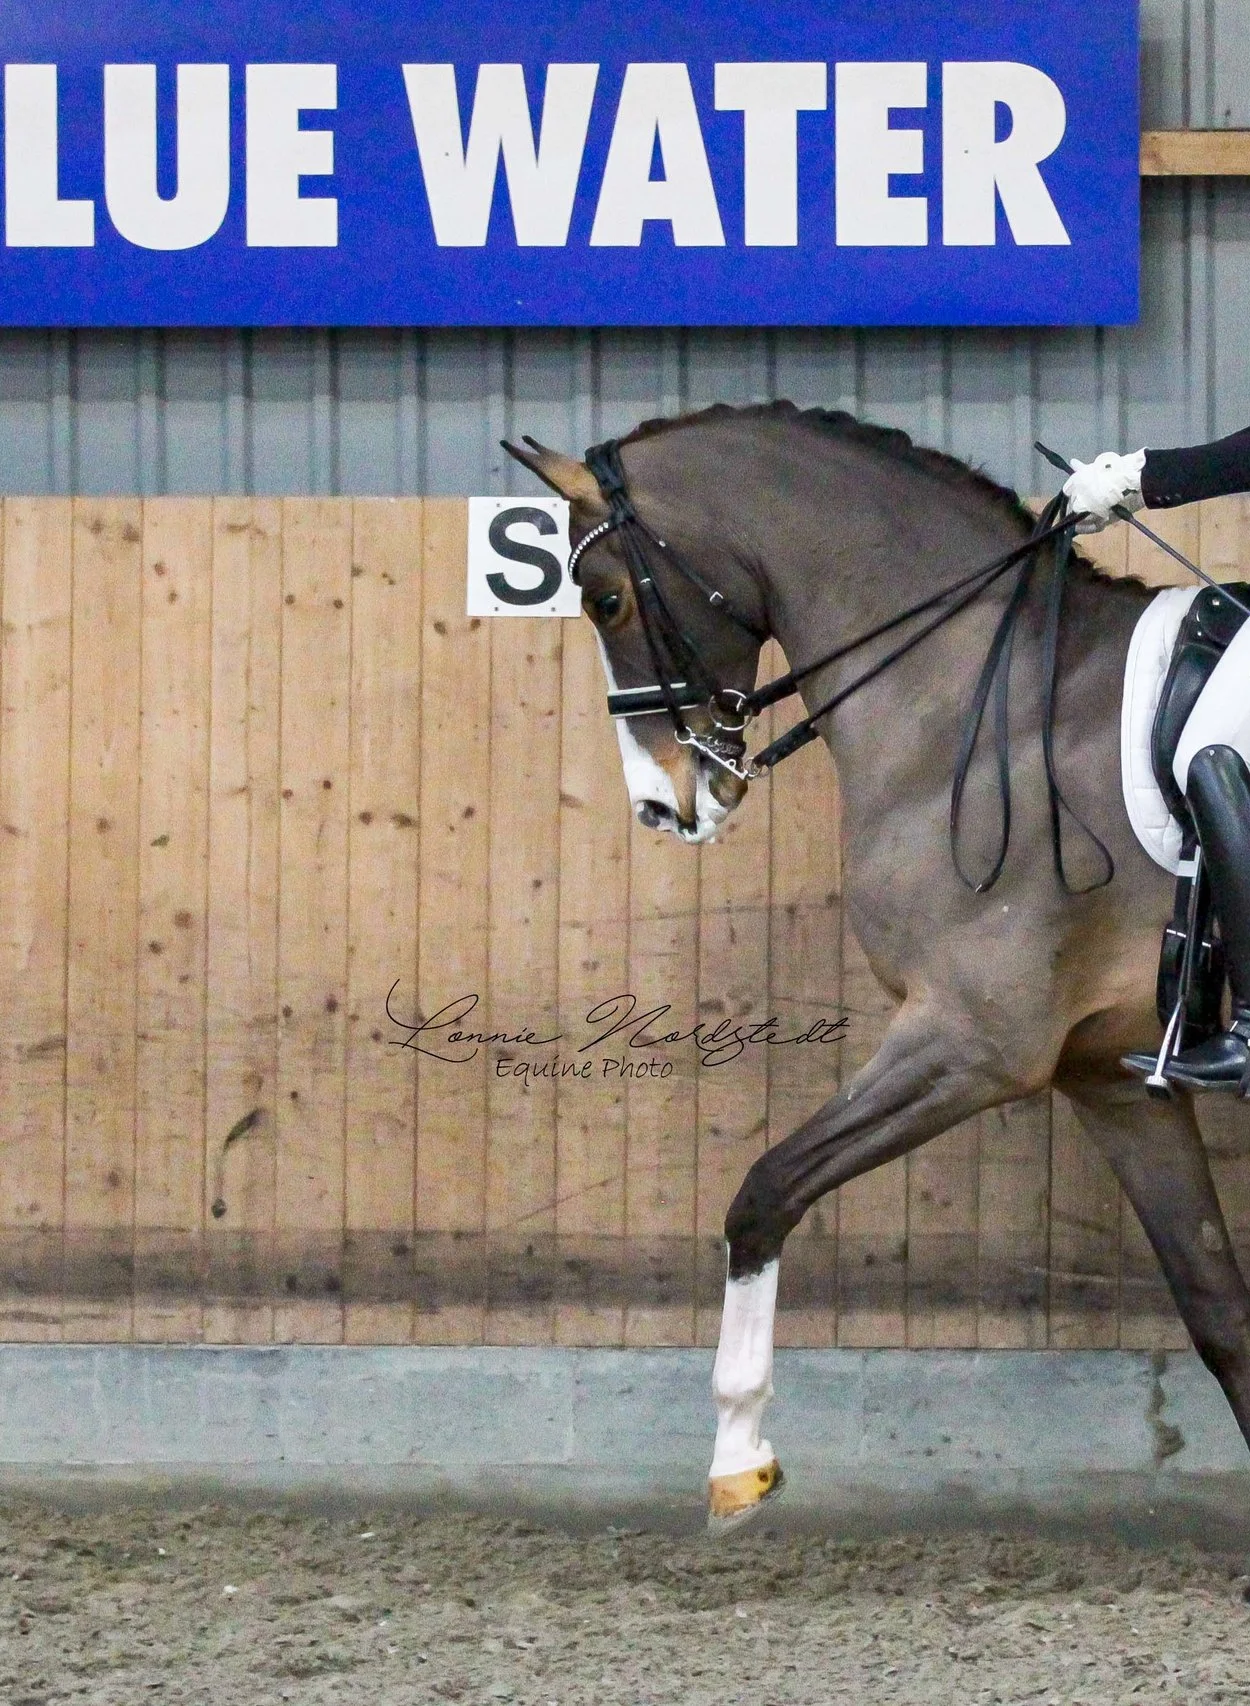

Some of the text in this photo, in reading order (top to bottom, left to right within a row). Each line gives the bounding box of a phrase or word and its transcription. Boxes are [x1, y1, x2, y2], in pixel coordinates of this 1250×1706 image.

[4, 61, 1071, 250] LUE WATER
[486, 506, 562, 606] S
